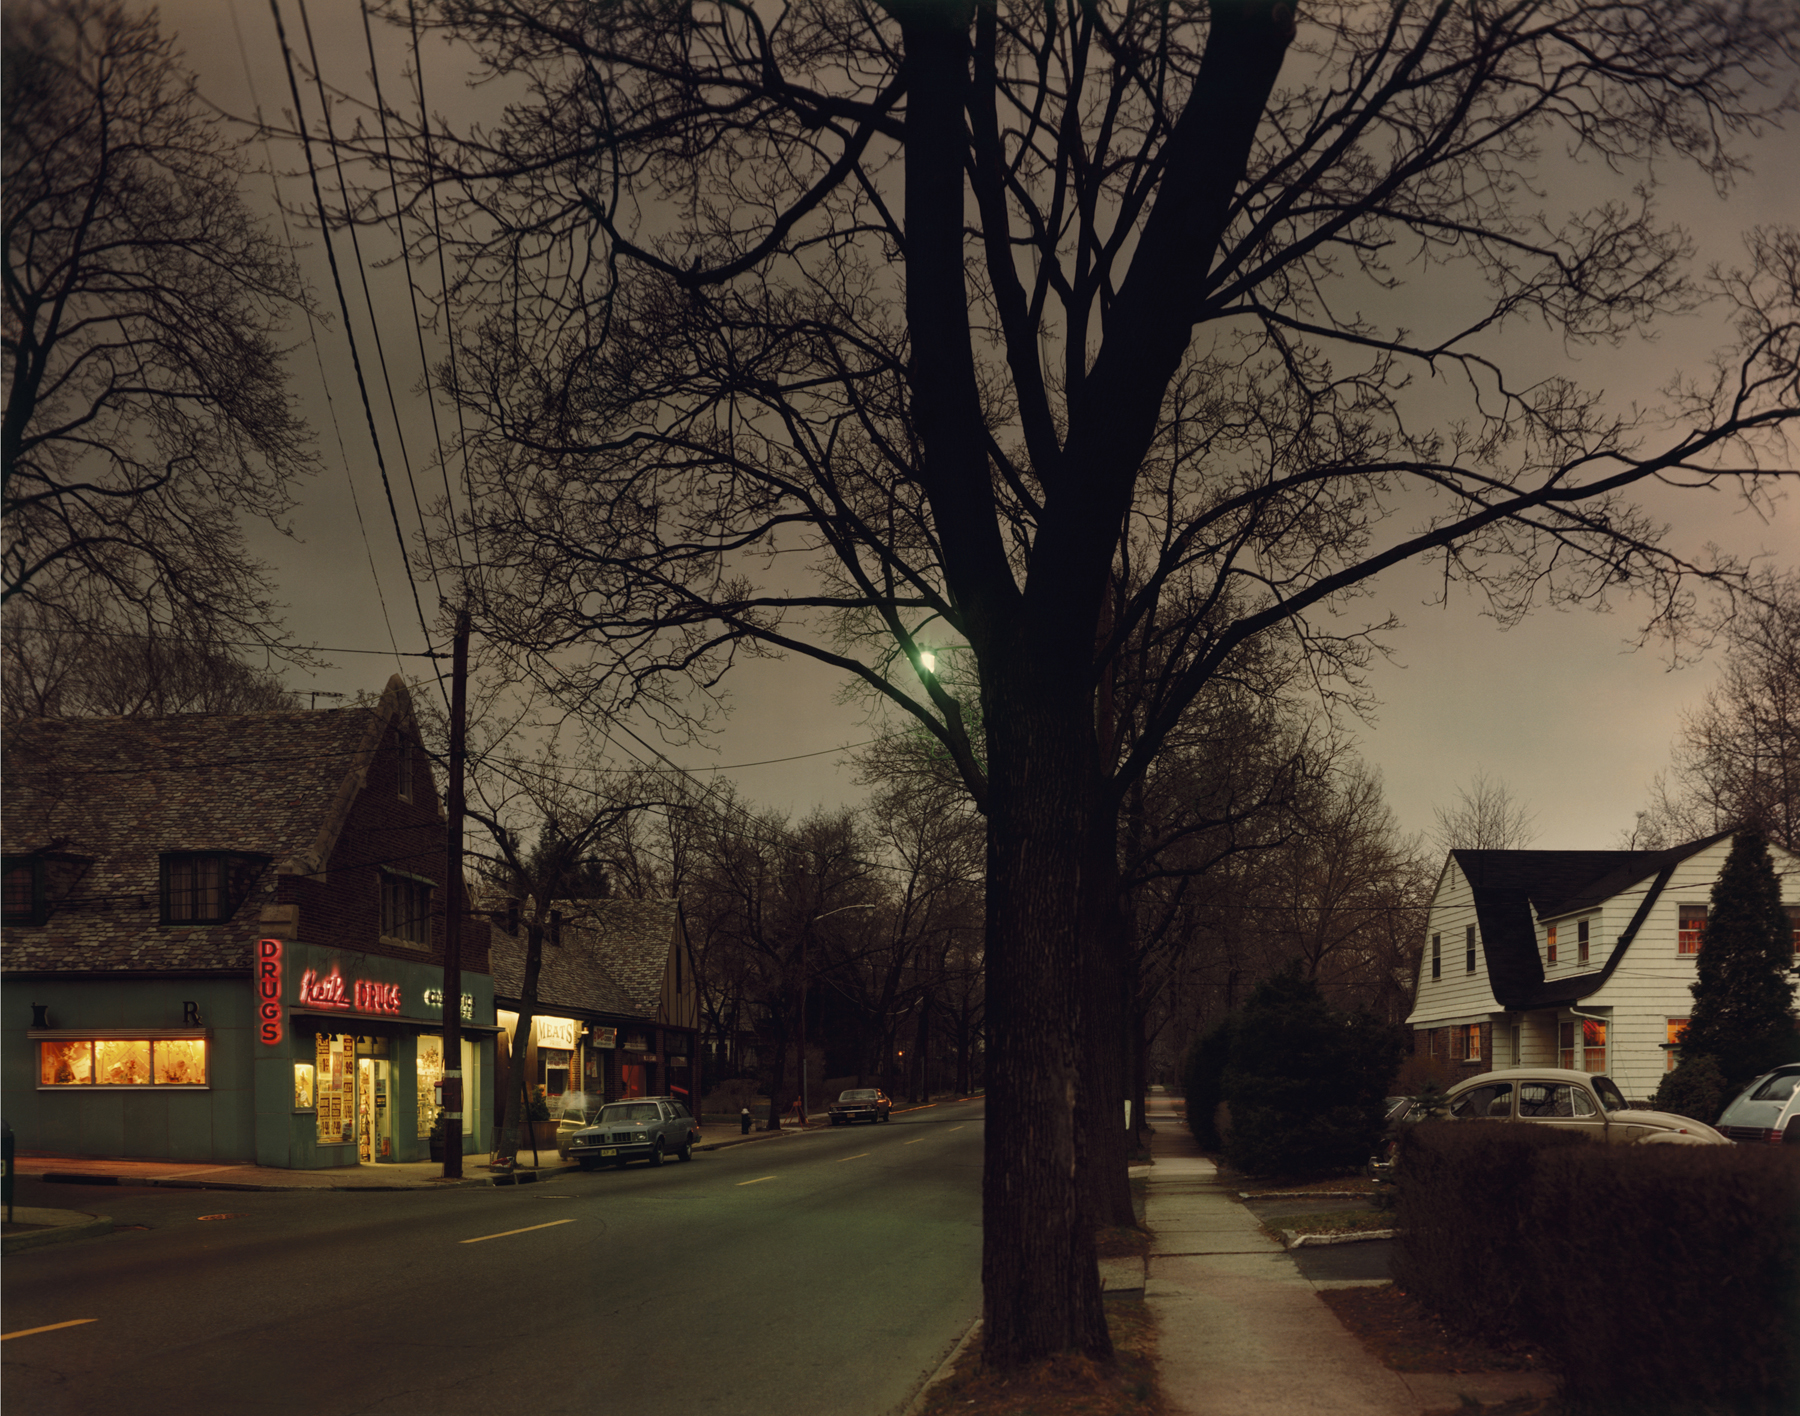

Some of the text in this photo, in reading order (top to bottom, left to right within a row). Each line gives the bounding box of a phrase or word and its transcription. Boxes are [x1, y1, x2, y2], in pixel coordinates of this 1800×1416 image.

[260, 940, 280, 1042] DRUGS
[355, 981, 403, 1014] DRUGS
[537, 1019, 573, 1044] MEATS
